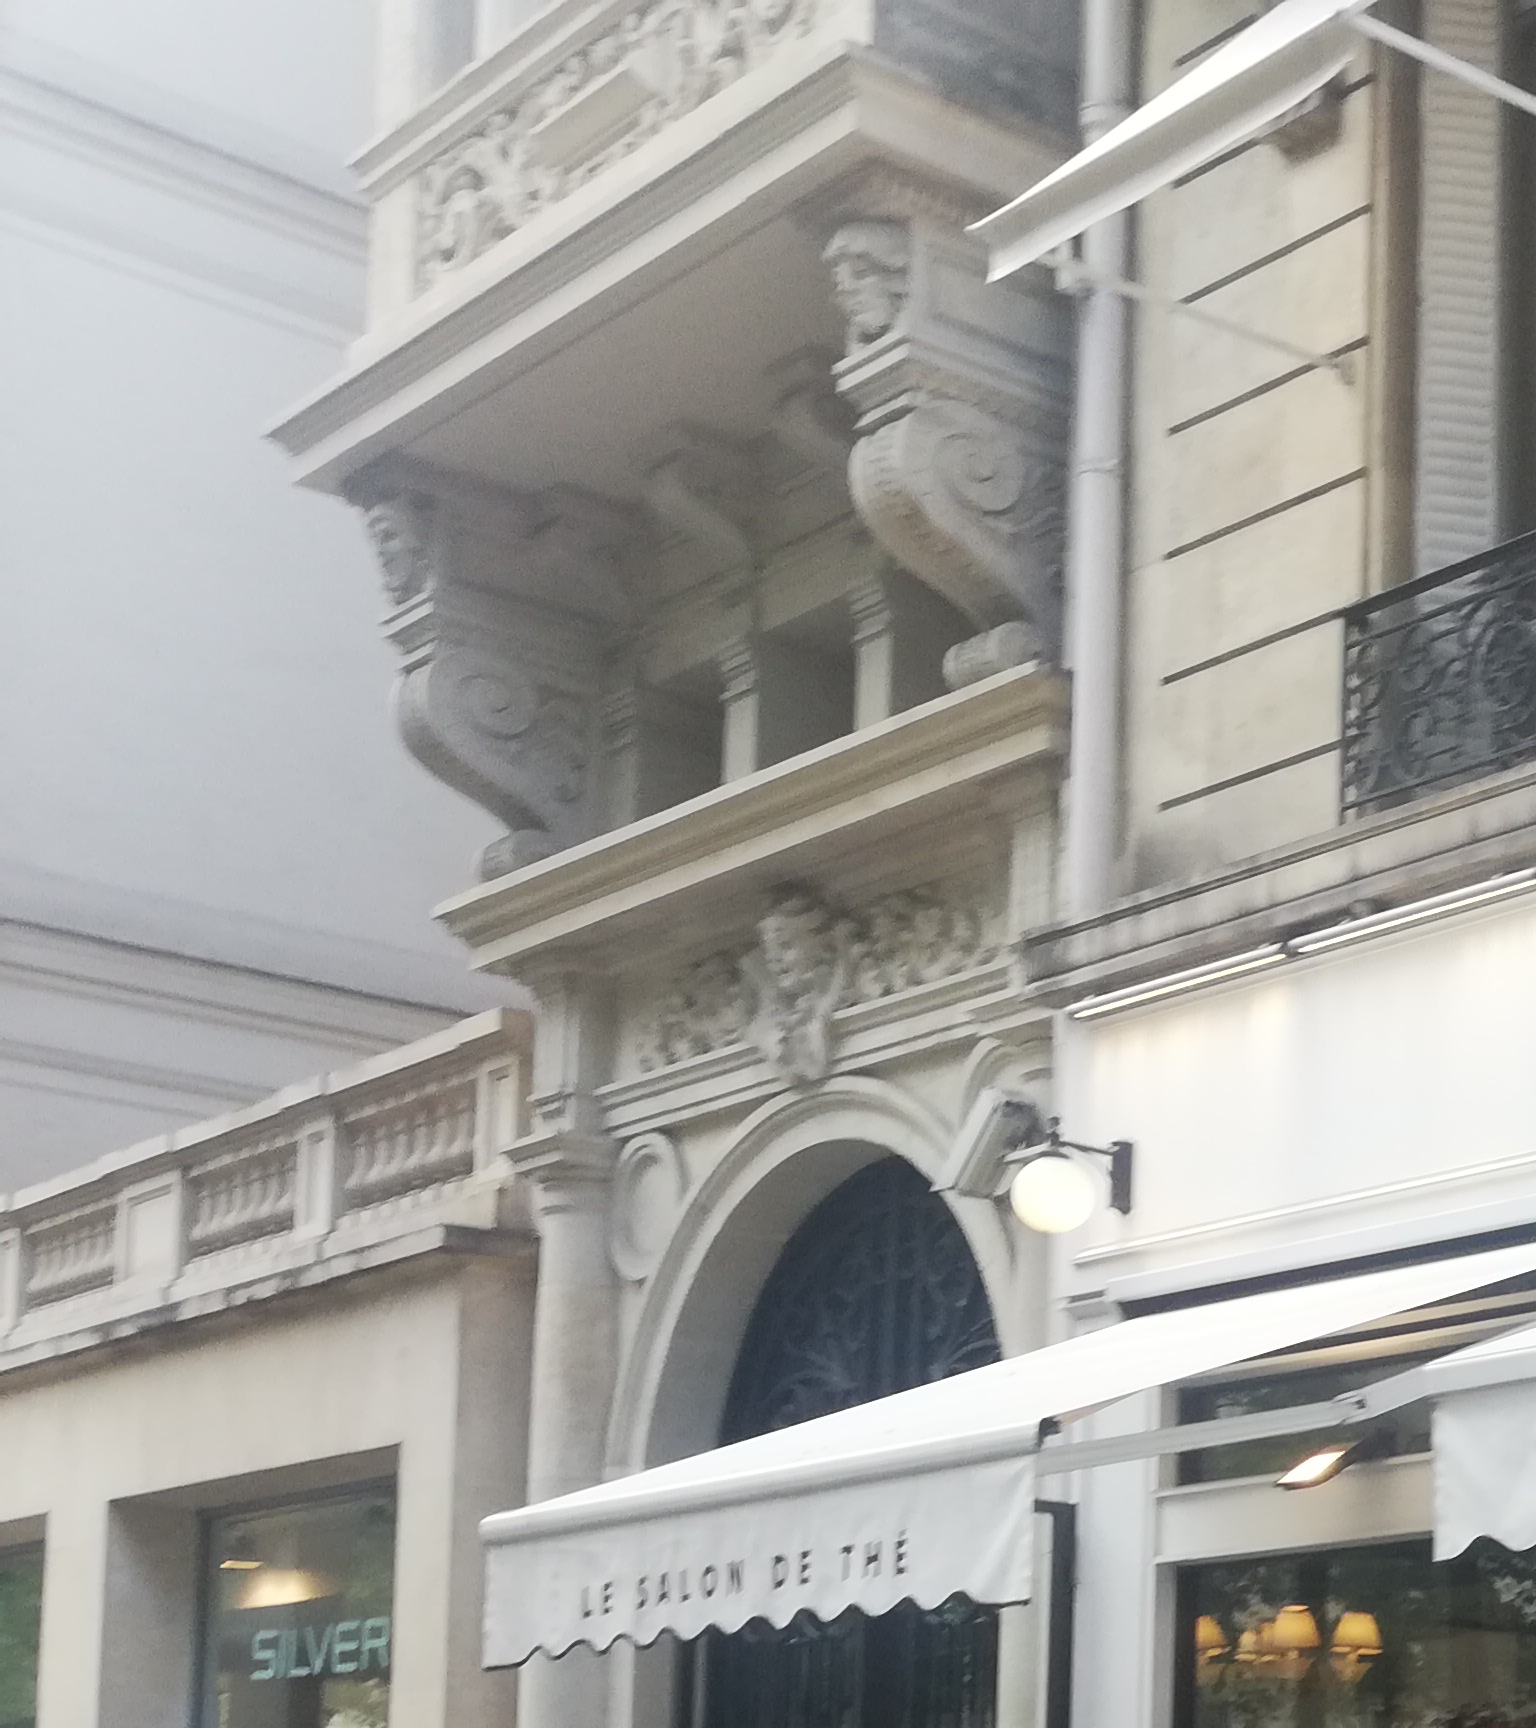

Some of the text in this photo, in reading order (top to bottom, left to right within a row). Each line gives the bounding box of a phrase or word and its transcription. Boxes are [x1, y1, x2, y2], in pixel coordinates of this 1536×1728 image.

[580, 1529, 909, 1619] LE SALON DE THÉ
[249, 1615, 390, 1681] SILVER
